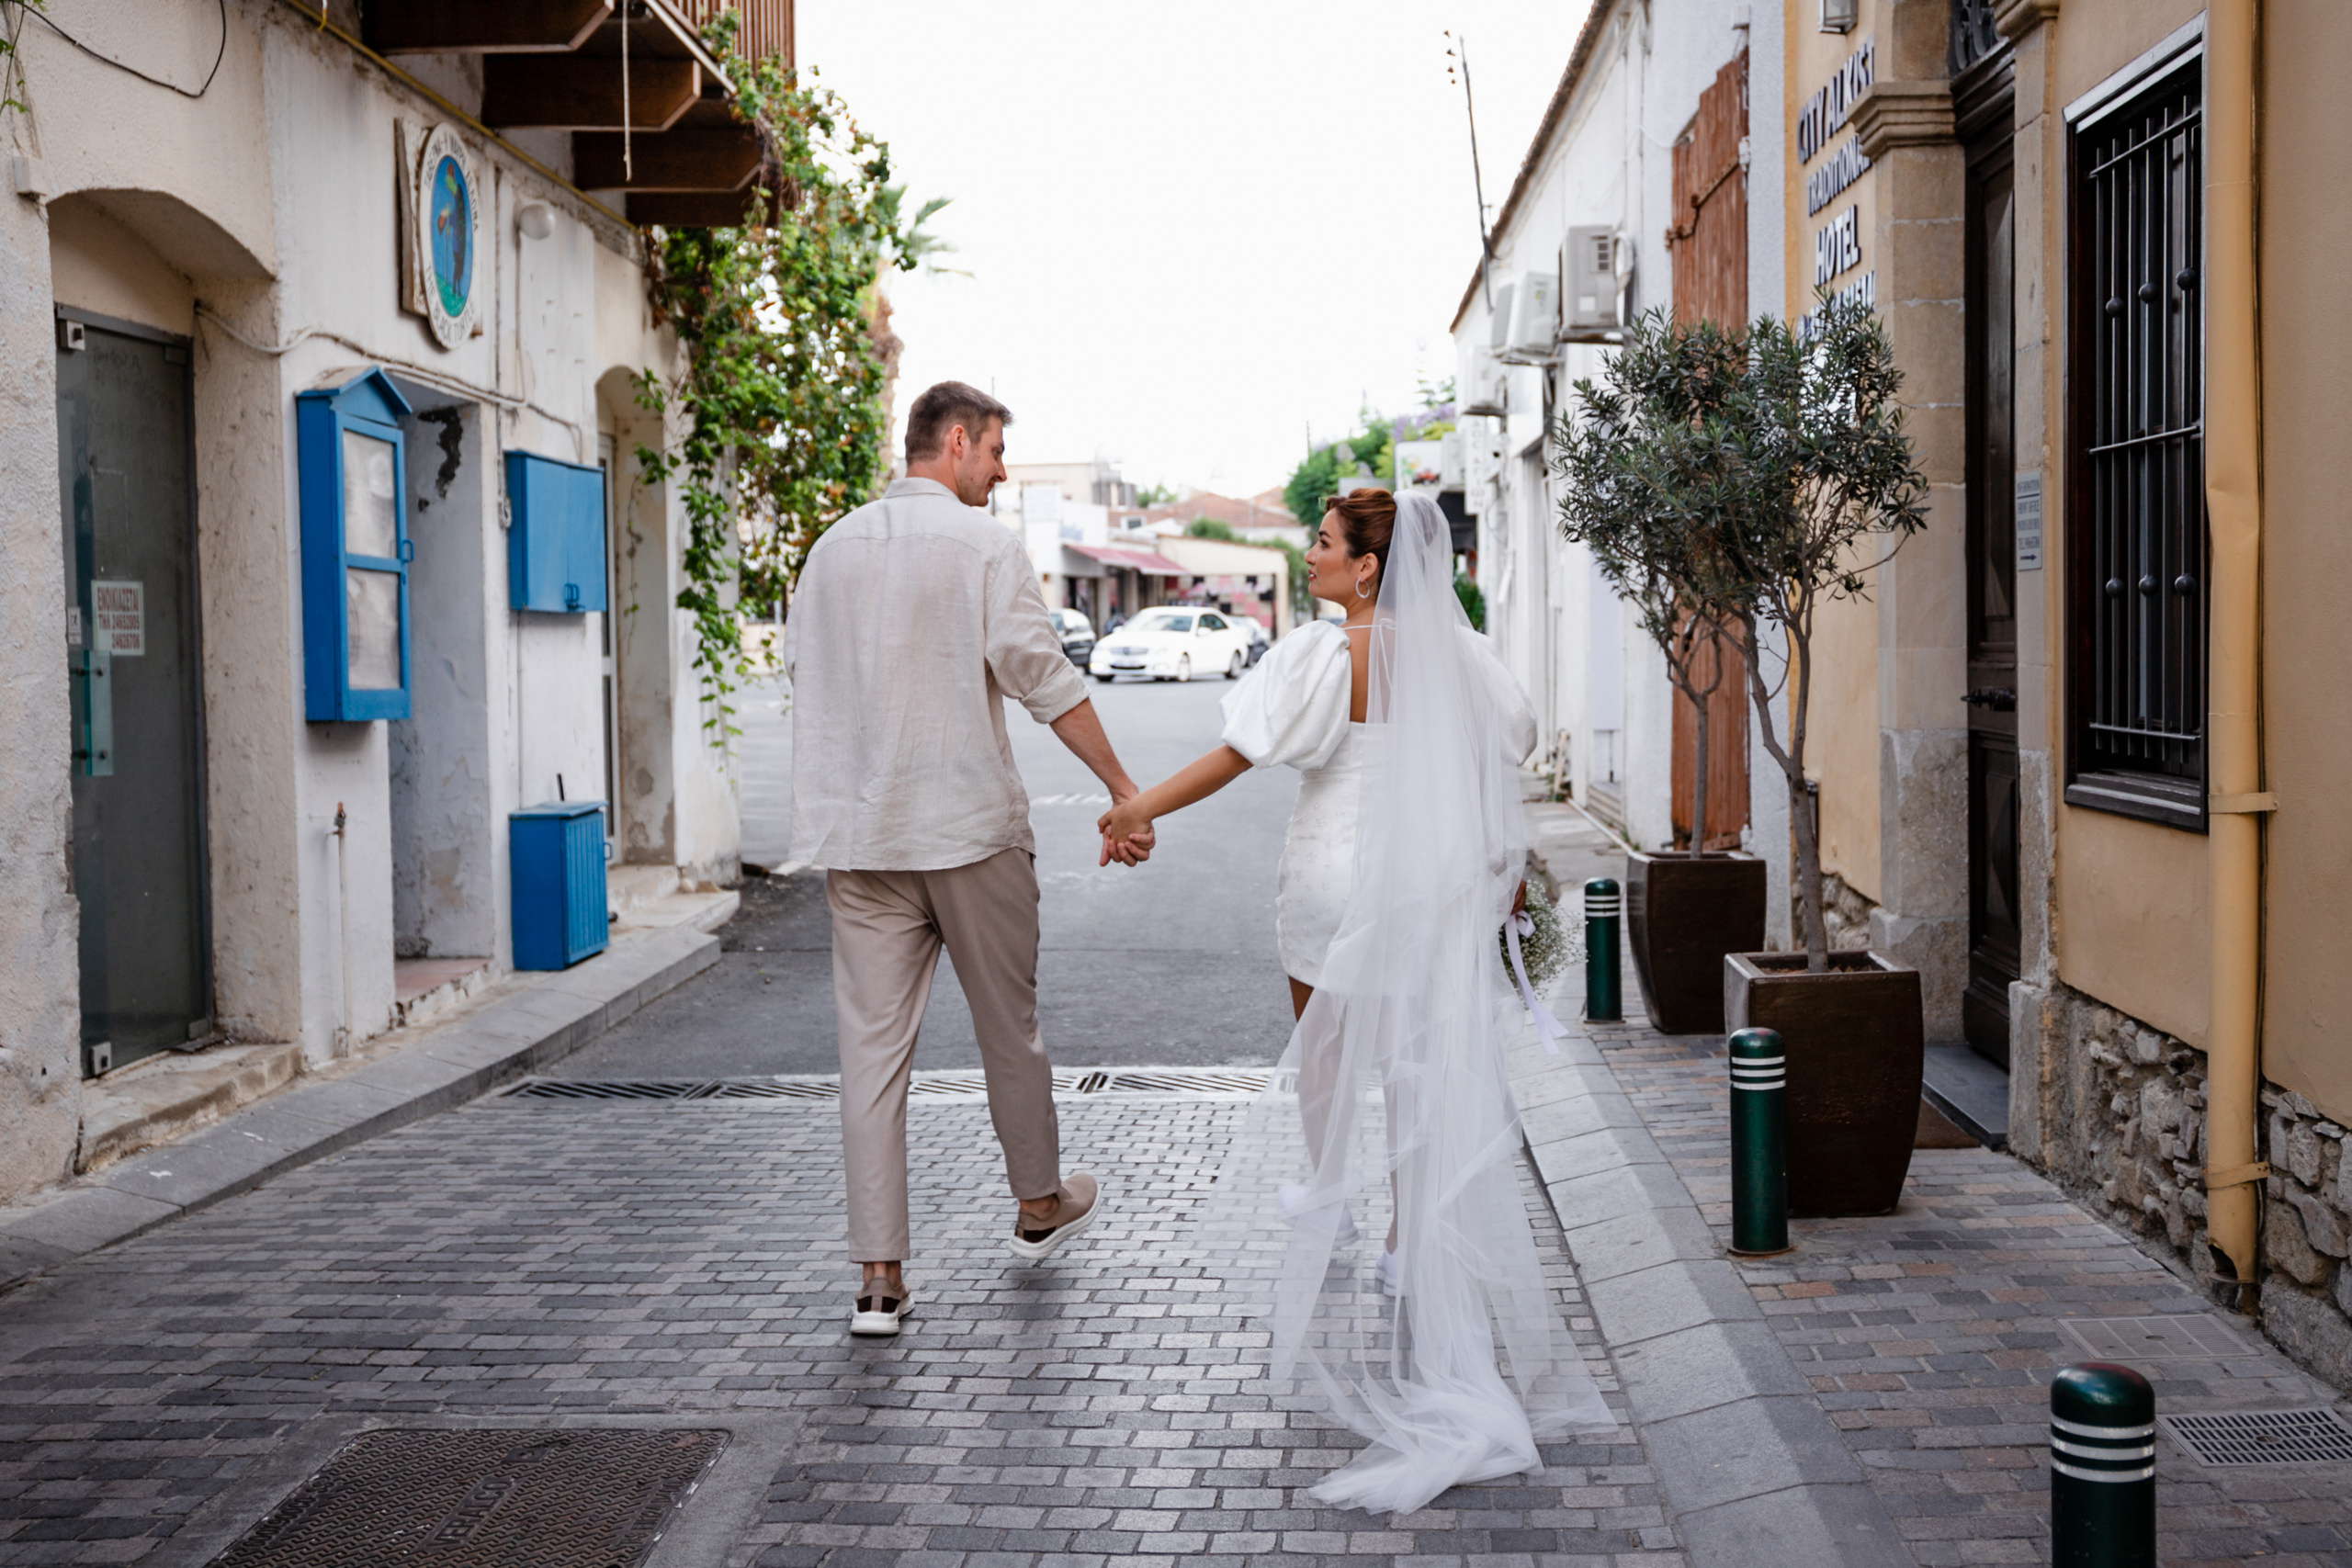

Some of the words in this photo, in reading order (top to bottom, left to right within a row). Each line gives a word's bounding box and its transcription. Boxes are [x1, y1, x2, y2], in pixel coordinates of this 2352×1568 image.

[1797, 85, 1826, 165] CITY
[1815, 203, 1861, 288] HOTEL
[425, 263, 435, 300] THE
[433, 299, 451, 343] BLACK
[453, 296, 475, 343] TURTLE
[96, 586, 140, 612] ΕΝΟΙΚΙΑΖΕΤΑΙ
[424, 1480, 514, 1548] VERALCO
